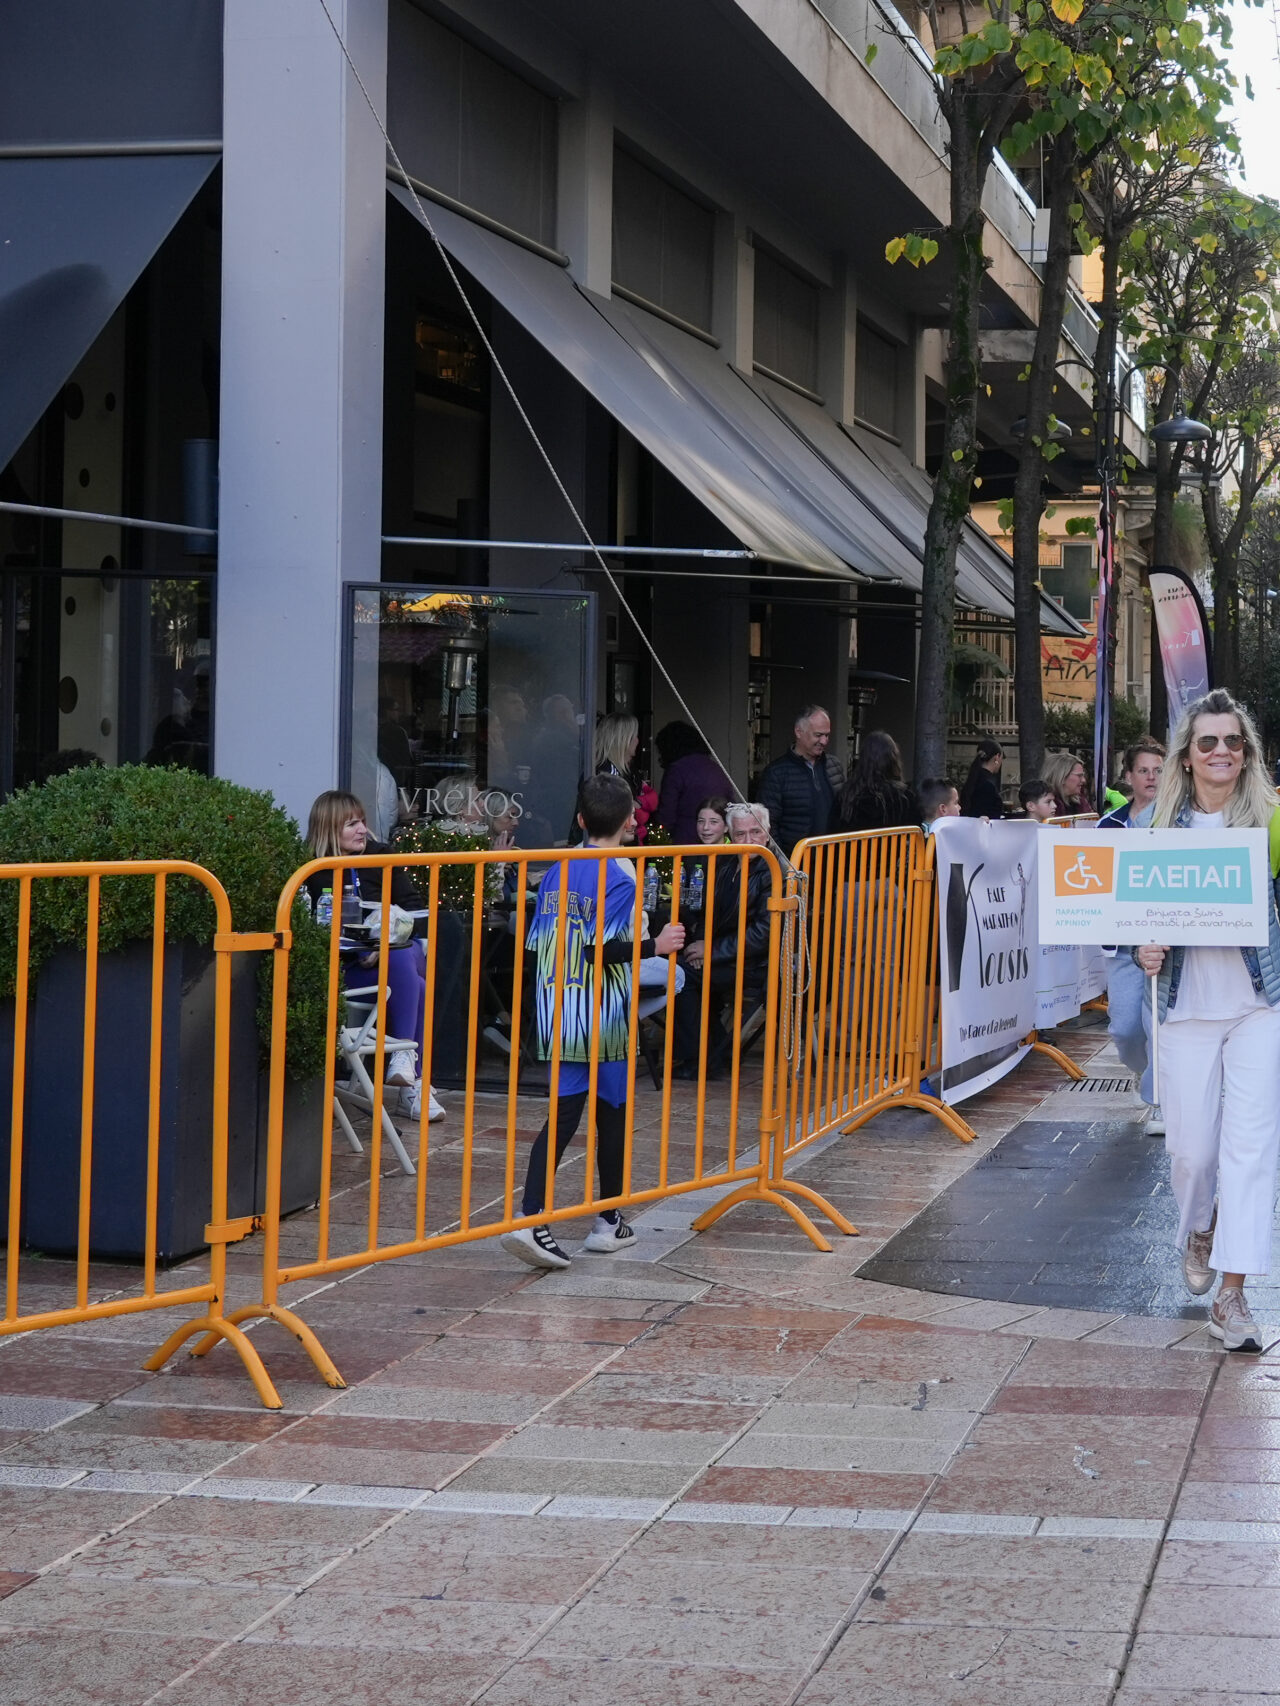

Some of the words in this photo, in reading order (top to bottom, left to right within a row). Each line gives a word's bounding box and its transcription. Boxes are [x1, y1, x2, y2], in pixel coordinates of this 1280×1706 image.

[1128, 865, 1242, 889] ΕΛΕΠΑΠ
[1055, 919, 1092, 927] ΑΓΡΙΝΙΟΥ
[1114, 919, 1132, 928] για
[1150, 918, 1180, 927] παιδί
[1182, 919, 1197, 928] με
[1199, 918, 1253, 928] αναπηρία
